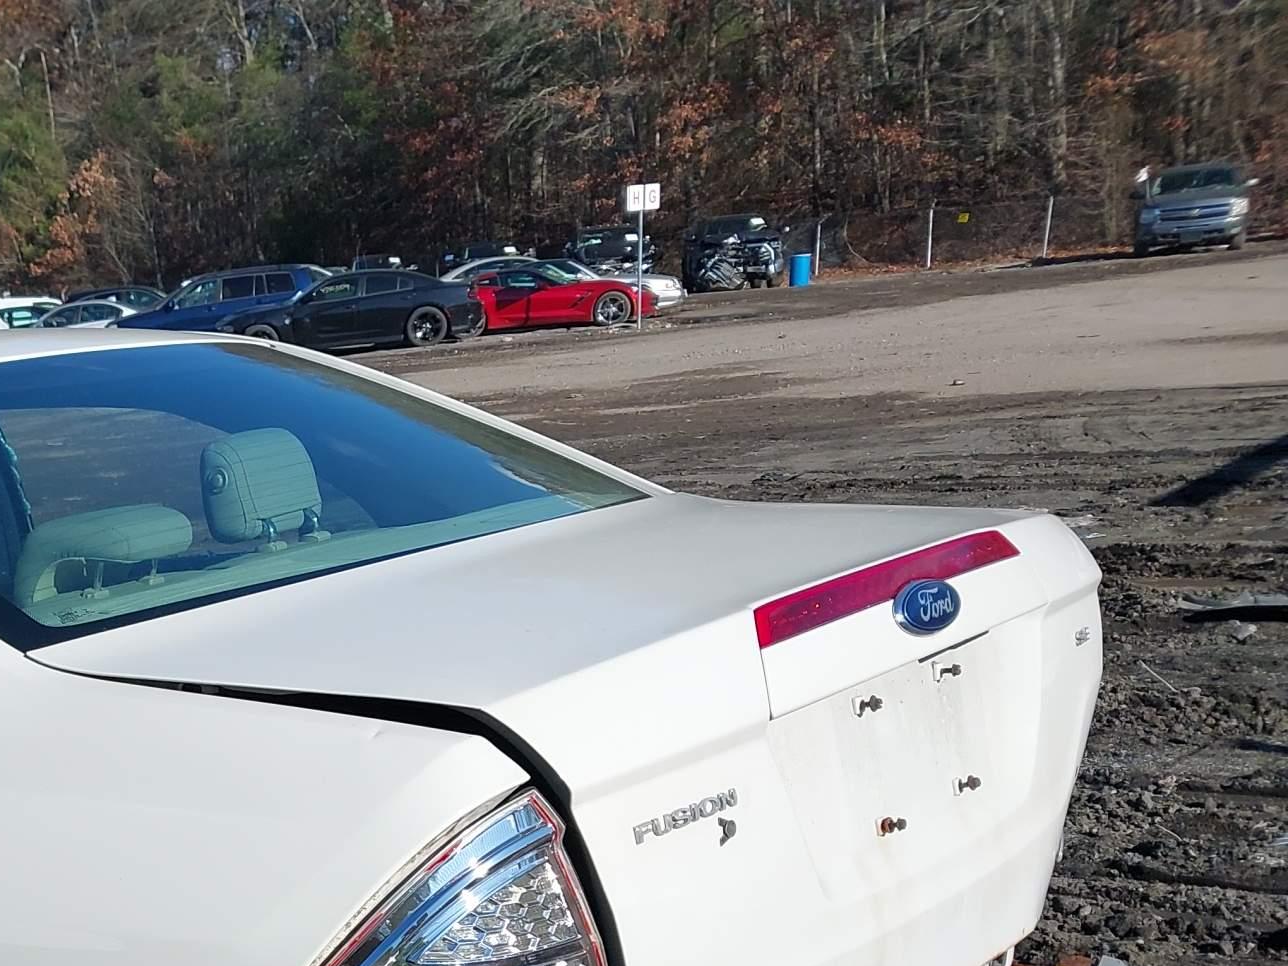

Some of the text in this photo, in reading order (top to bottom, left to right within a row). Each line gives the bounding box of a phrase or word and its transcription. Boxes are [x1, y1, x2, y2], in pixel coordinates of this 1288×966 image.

[633, 189, 657, 206] H G
[917, 586, 954, 622] Ford
[632, 787, 739, 846] FUSION
